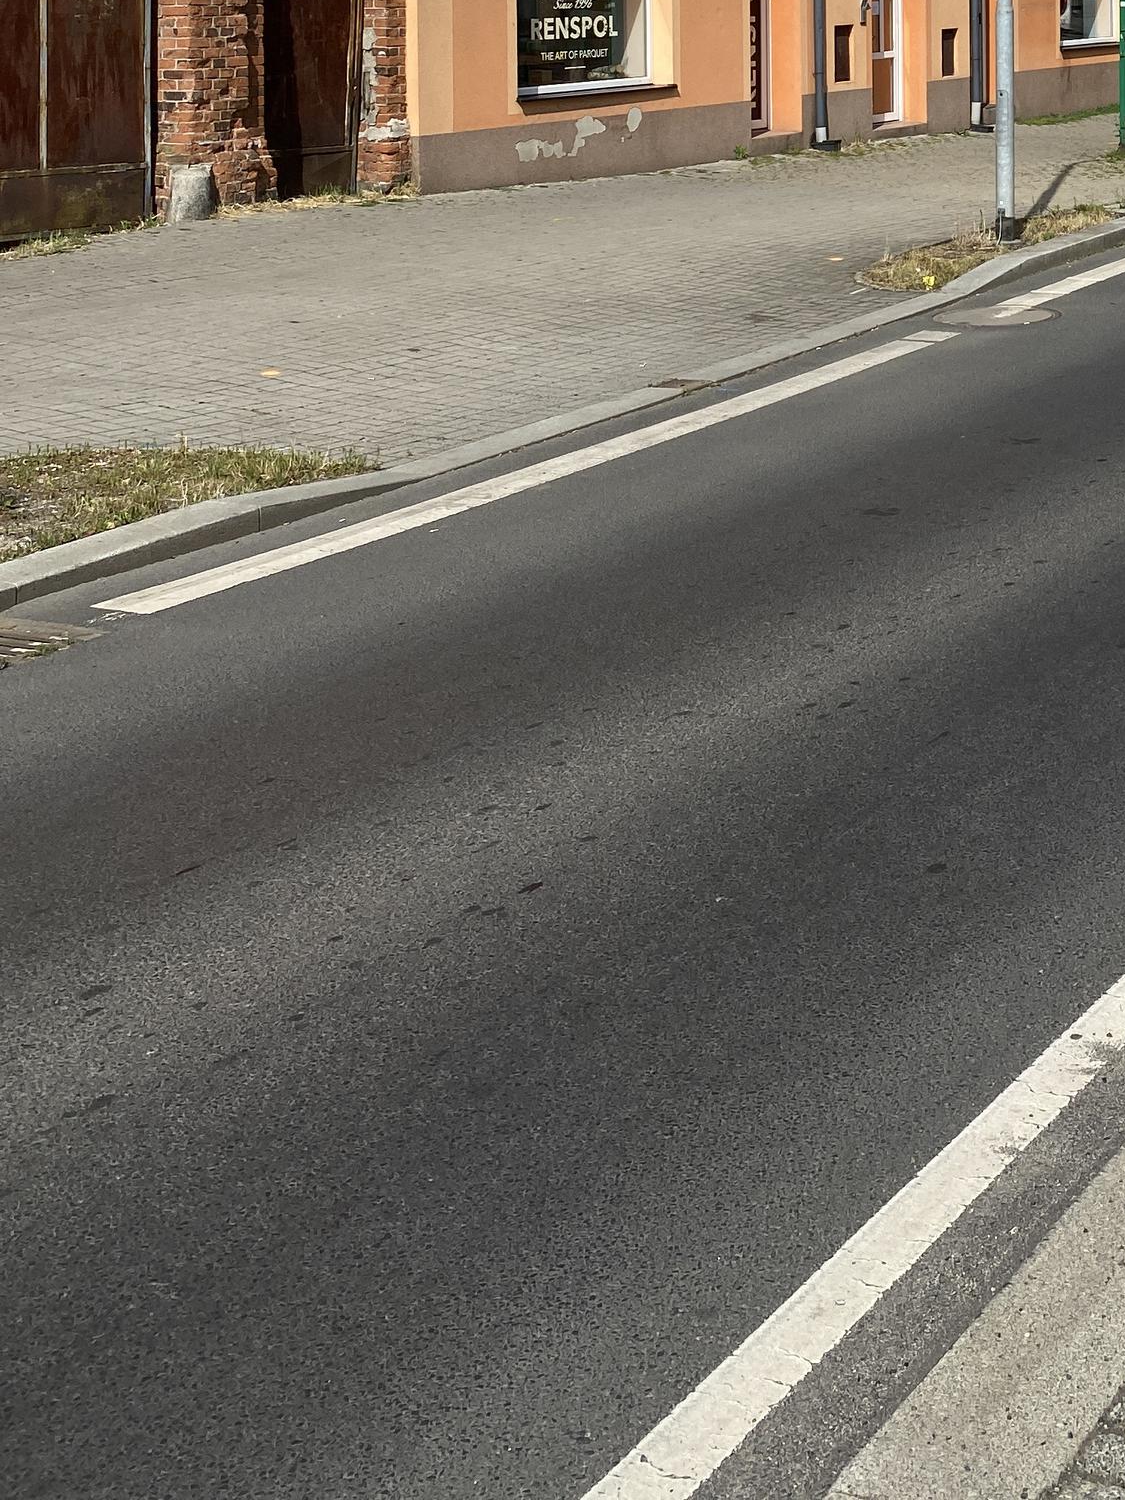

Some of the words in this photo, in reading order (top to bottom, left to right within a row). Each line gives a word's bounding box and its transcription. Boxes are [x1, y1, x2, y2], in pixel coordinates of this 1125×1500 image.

[530, 15, 618, 40] RENSPOL
[540, 51, 554, 61] THE
[554, 51, 568, 61] ART
[568, 50, 578, 60] OF
[579, 48, 608, 59] PARQUET
